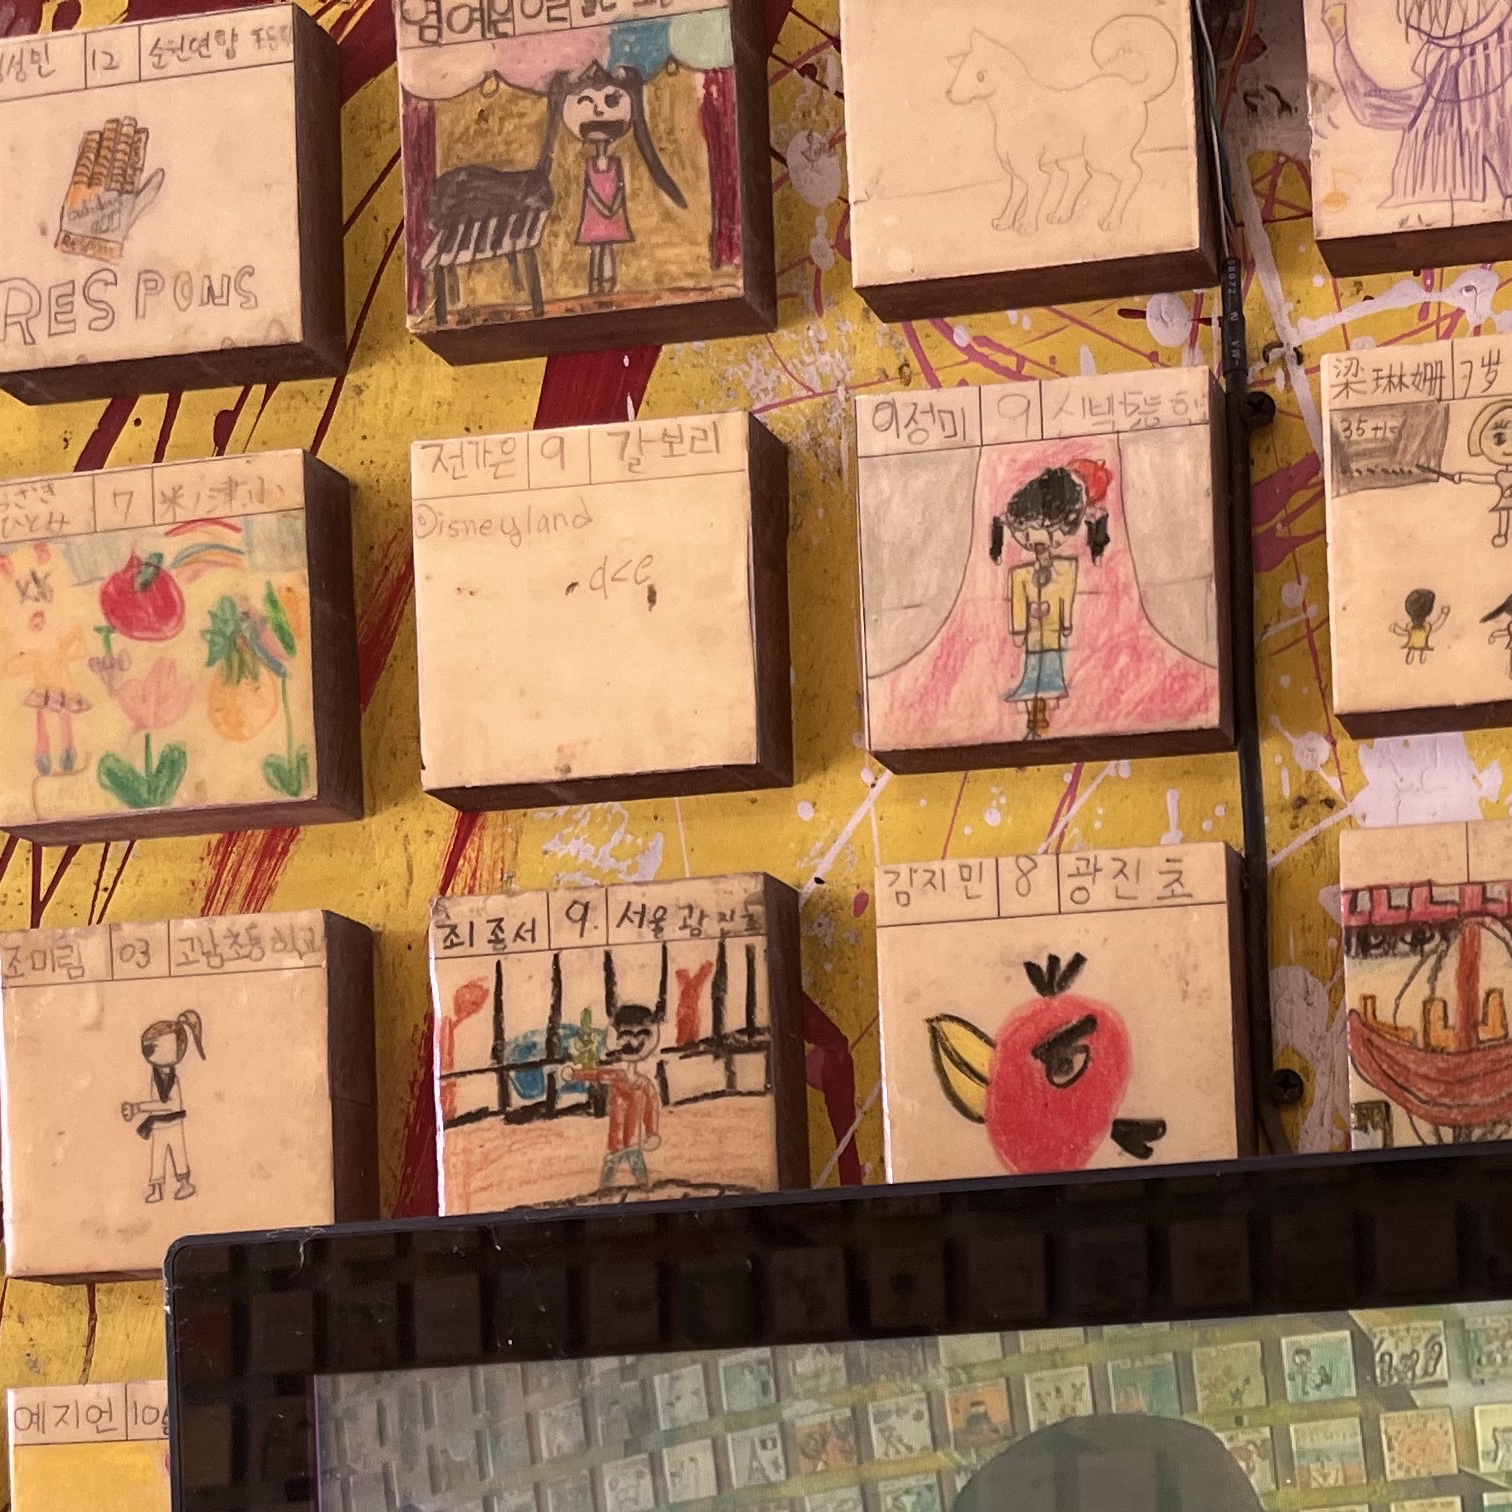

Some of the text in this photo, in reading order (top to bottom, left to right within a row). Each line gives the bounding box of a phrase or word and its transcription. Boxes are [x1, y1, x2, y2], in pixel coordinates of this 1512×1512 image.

[91, 48, 121, 71] 12
[414, 496, 593, 548] Disneyland
[883, 861, 985, 908] 김지민
[1014, 855, 1038, 898] 8
